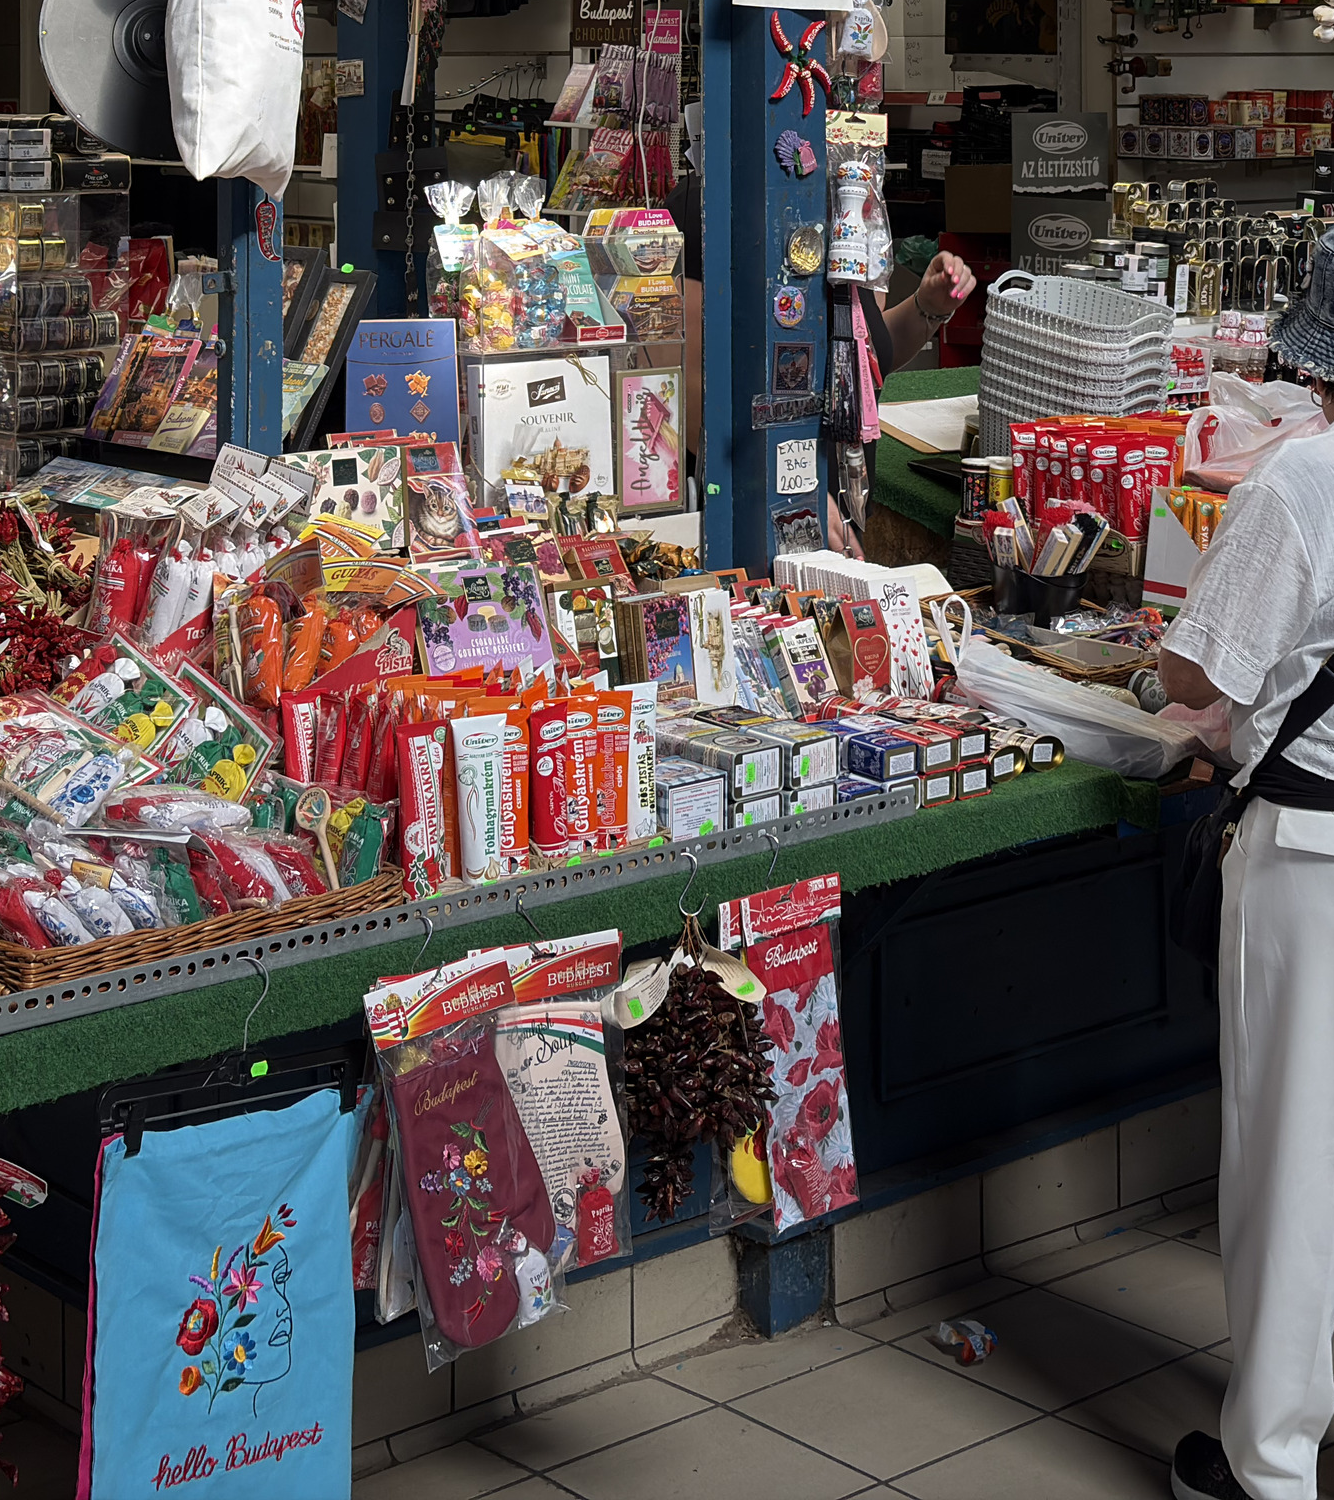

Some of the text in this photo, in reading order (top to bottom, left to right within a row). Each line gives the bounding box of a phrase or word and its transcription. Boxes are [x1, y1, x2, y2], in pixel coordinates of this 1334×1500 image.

[575, 26, 639, 42] CHOCOLATE
[647, 30, 679, 45] Candies
[1038, 132, 1084, 144] Univer
[1021, 156, 1100, 178] AZ ÉLETÍZESÍTŐ
[638, 219, 670, 227] BUDAPEST
[1034, 225, 1087, 240] Univer
[640, 286, 673, 294] BUDAPEST
[111, 336, 133, 376] Budapest
[153, 341, 187, 355] Budapest
[166, 411, 197, 428] Budapest
[520, 411, 577, 425] SOUVENIR
[778, 440, 815, 456] EXTRA
[1198, 524, 1209, 554] ULYÁS
[330, 566, 379, 582] GULYÁS
[458, 642, 526, 658] GOURMET DESSZERT
[379, 656, 413, 675] PISTA
[542, 724, 566, 738] Univer
[465, 736, 498, 746] Univer
[570, 739, 591, 833] Gulyáskrém
[600, 732, 618, 827] Gulyáskrém
[637, 753, 649, 809] ERŐS PISTÁS
[480, 759, 497, 857] Fokhagymakrém
[764, 939, 819, 970] Budapest
[547, 961, 613, 987] BUDAPEST
[566, 979, 594, 989] HUNGARY
[441, 981, 507, 1016] BUDAPEST
[462, 1001, 490, 1015] HUNGARY
[533, 1031, 579, 1066] Soup
[414, 1069, 479, 1116] Budapest
[591, 1203, 614, 1219] Paprika
[151, 1421, 324, 1492] hello Budapest
